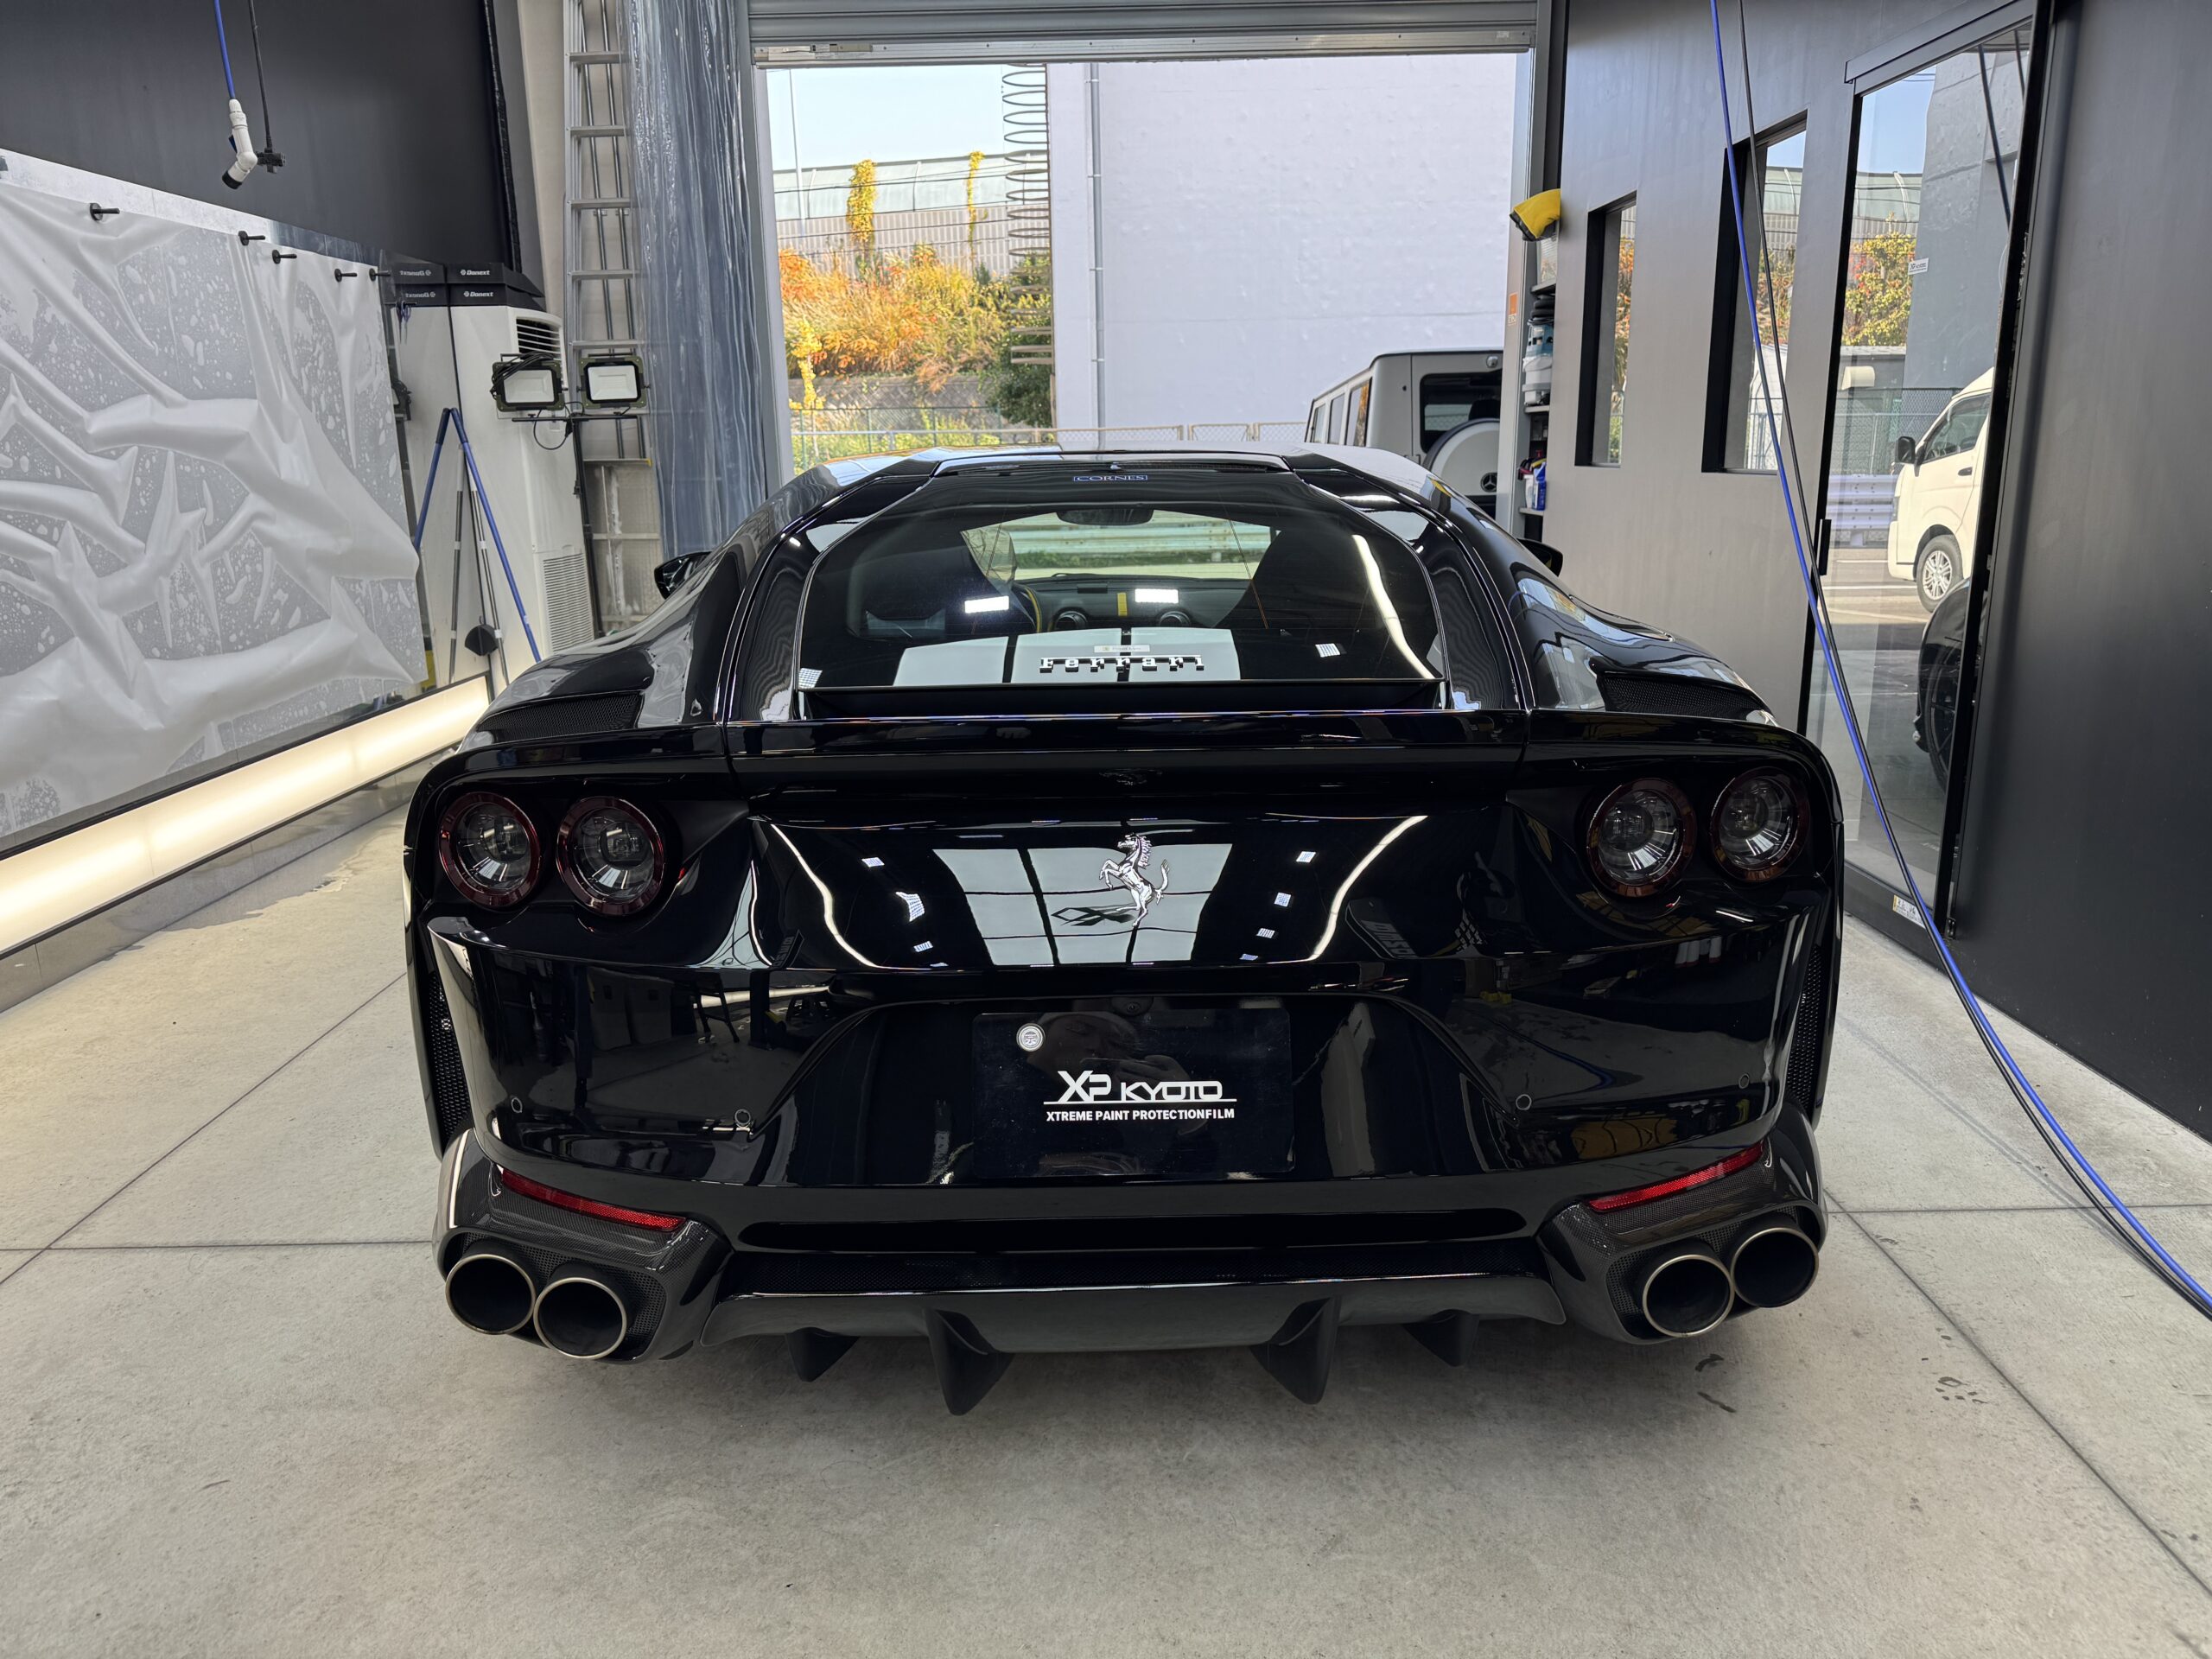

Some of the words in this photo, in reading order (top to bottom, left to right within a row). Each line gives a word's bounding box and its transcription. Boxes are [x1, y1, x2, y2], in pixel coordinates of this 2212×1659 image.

[1039, 656, 1204, 671] Ferrari
[1121, 1081, 1223, 1102] KYOTO
[1046, 1110, 1093, 1122] XTREME
[1096, 1109, 1130, 1121] PAINT
